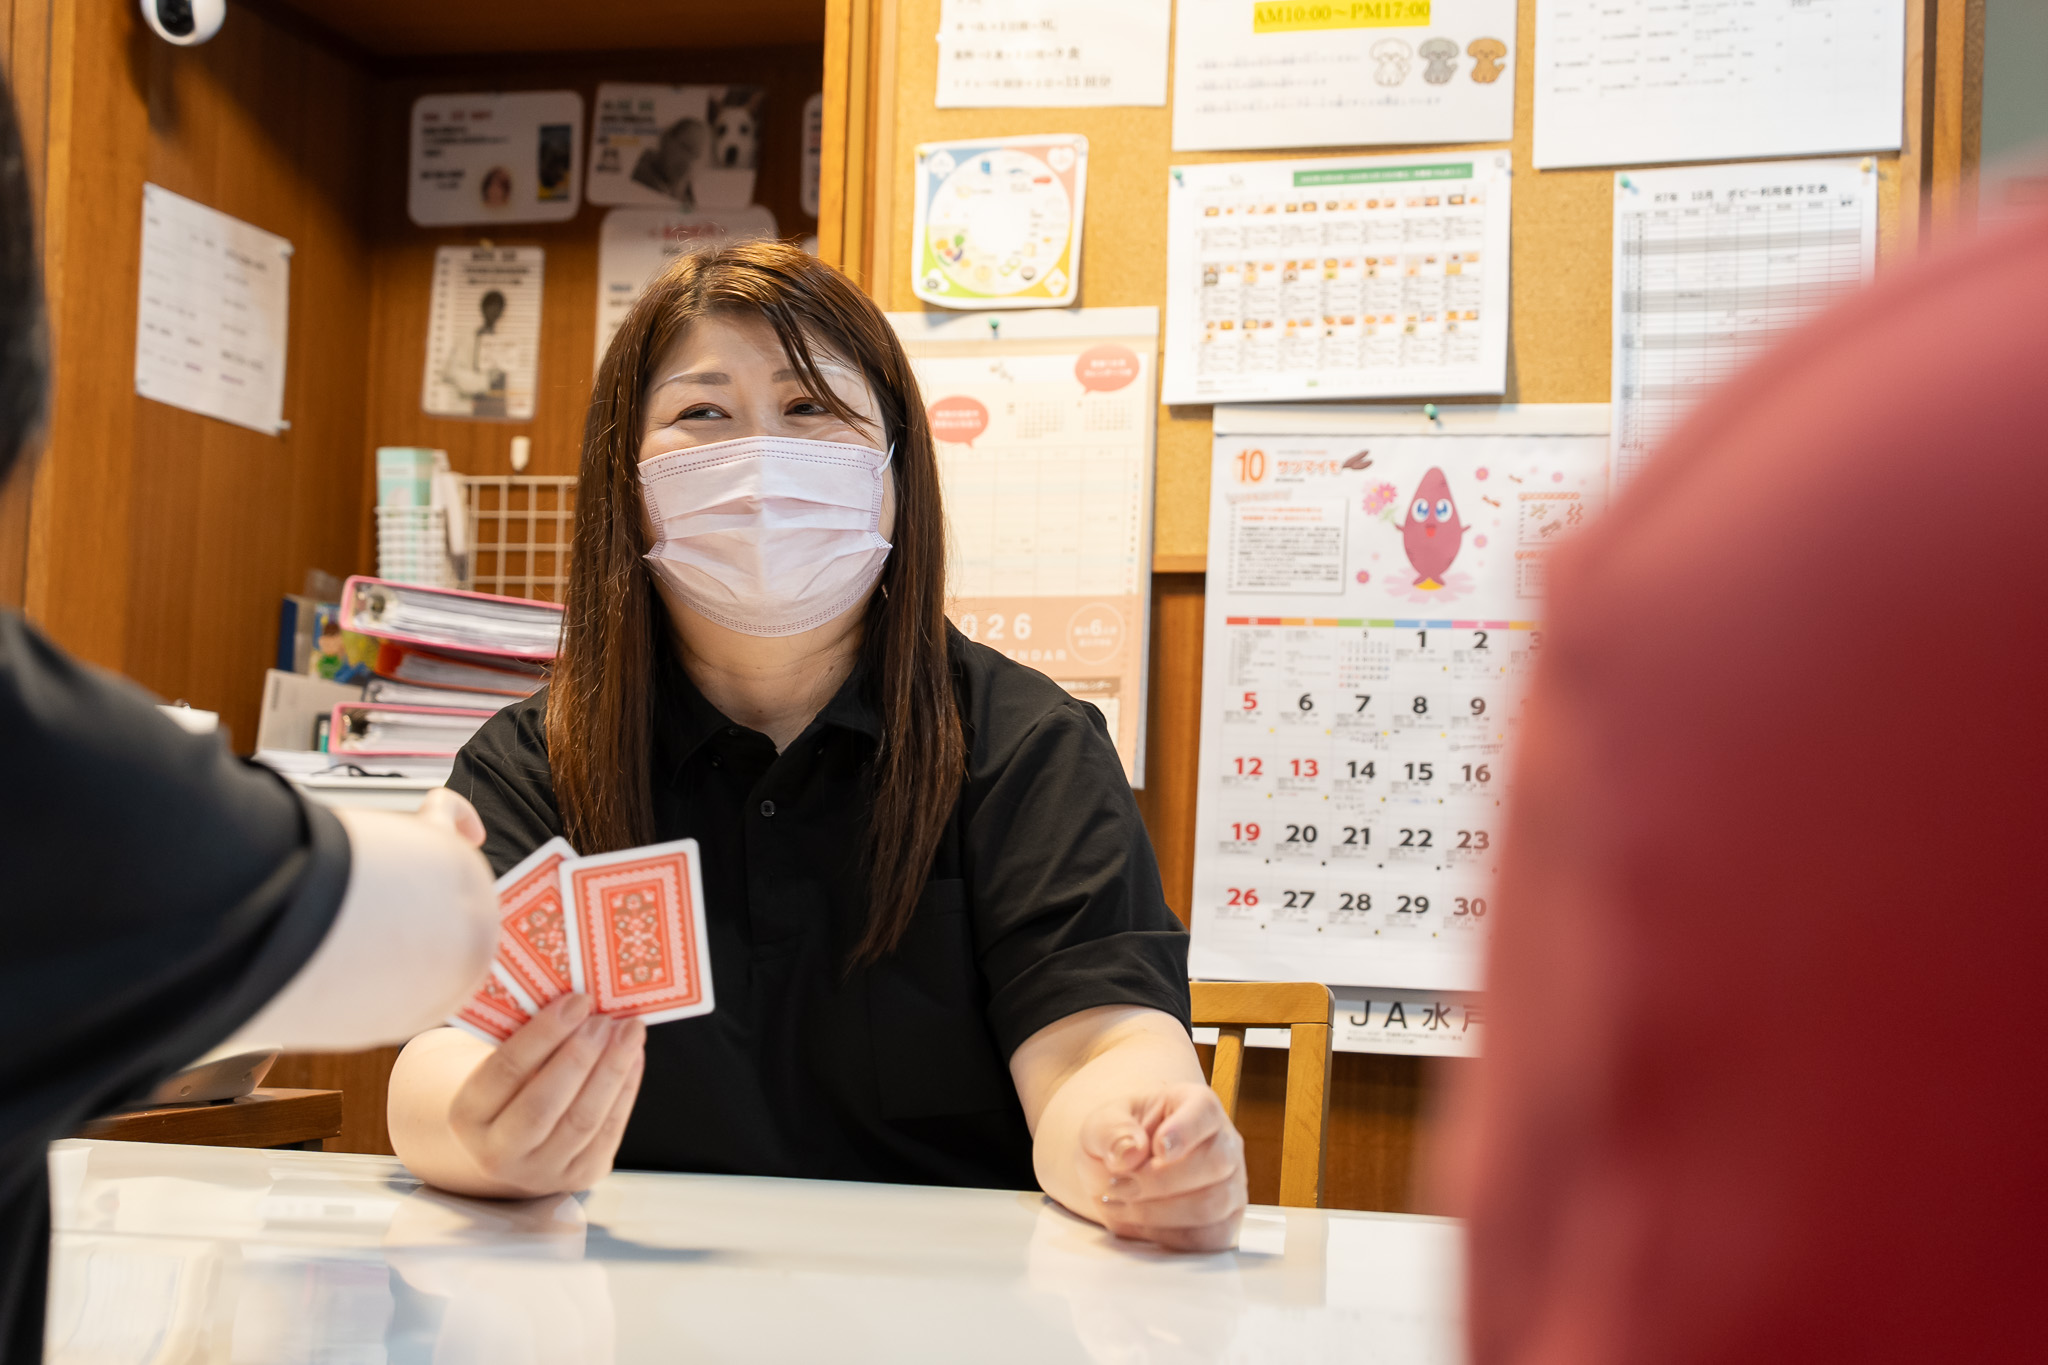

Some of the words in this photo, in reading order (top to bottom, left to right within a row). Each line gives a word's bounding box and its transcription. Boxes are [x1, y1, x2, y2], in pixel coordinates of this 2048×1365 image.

[1236, 450, 1265, 483] 10
[1277, 460, 1341, 476] サツマイモ
[1417, 631, 1426, 648] 1
[1473, 632, 1488, 649] 2
[1243, 692, 1257, 710] 5
[1299, 694, 1313, 711] 6
[1355, 695, 1370, 712] 7
[1412, 696, 1427, 714] 8
[1470, 698, 1485, 716] 9
[1234, 758, 1263, 776] 12
[1290, 760, 1319, 777] 13
[1347, 761, 1375, 778] 14
[1404, 763, 1433, 780] 15
[1462, 764, 1491, 782] 16
[1232, 823, 1260, 841] 19
[1286, 825, 1317, 843] 20
[1343, 827, 1370, 844] 21
[1400, 829, 1432, 847] 22
[1456, 831, 1490, 850] 23
[1227, 888, 1259, 907] 26
[1283, 891, 1315, 909] 27
[1340, 893, 1371, 911] 28
[1397, 896, 1429, 914] 29
[1453, 898, 1487, 917] 30
